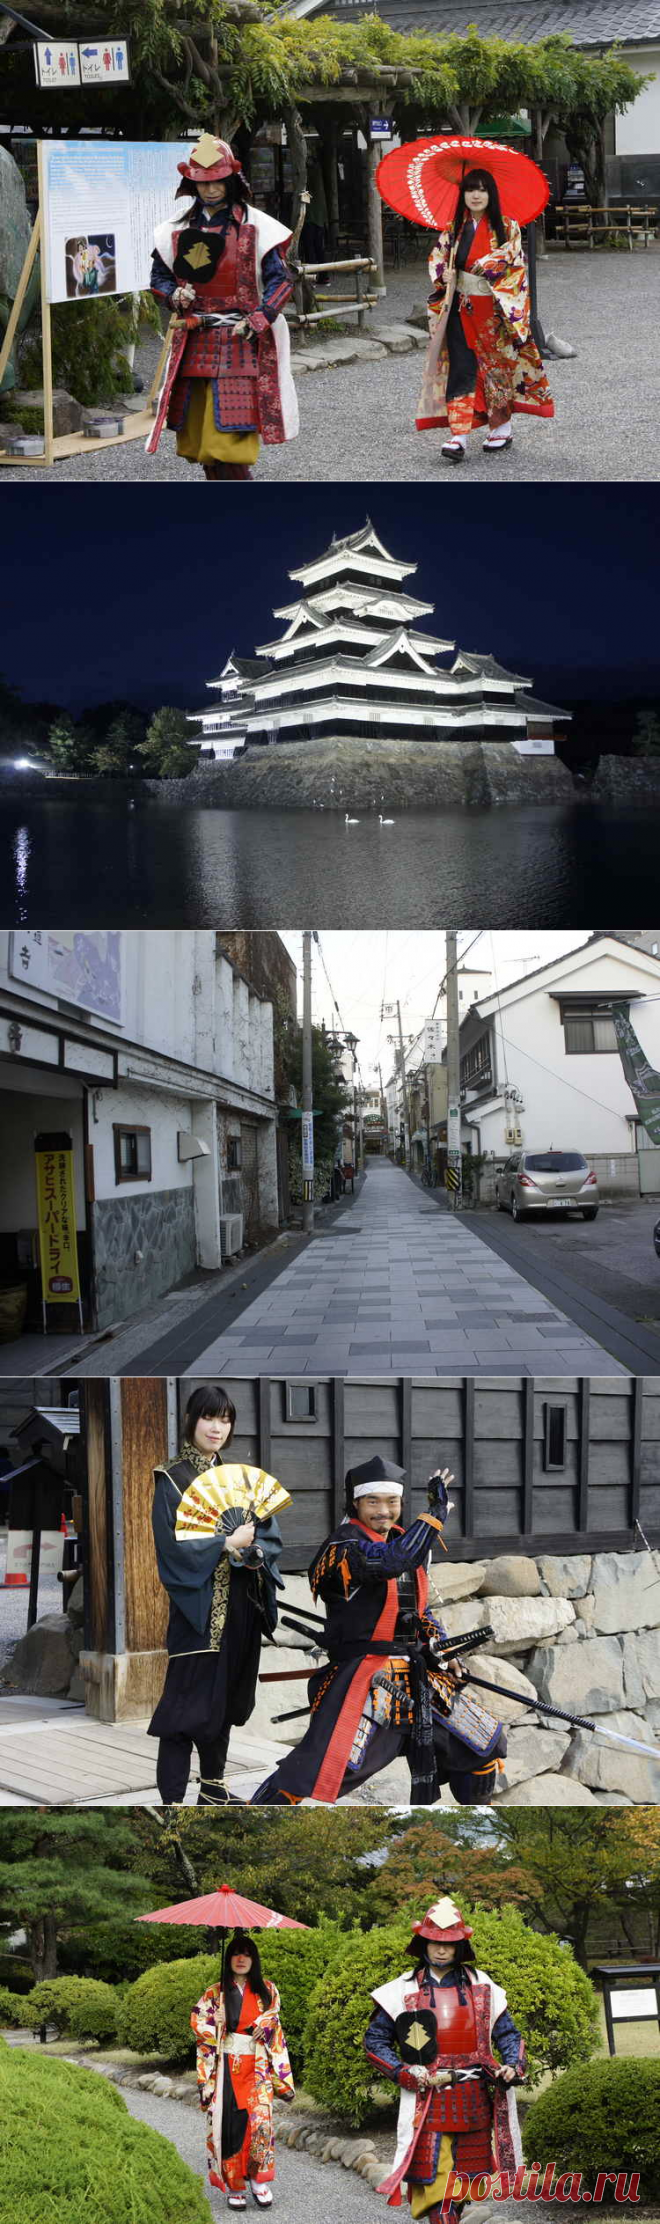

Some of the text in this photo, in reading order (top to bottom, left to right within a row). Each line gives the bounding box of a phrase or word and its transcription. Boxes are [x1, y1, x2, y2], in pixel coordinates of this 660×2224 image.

[41, 67, 57, 76] トイレ
[82, 63, 101, 73] トイレ
[43, 1153, 62, 1275] アサヒスーパードライ
